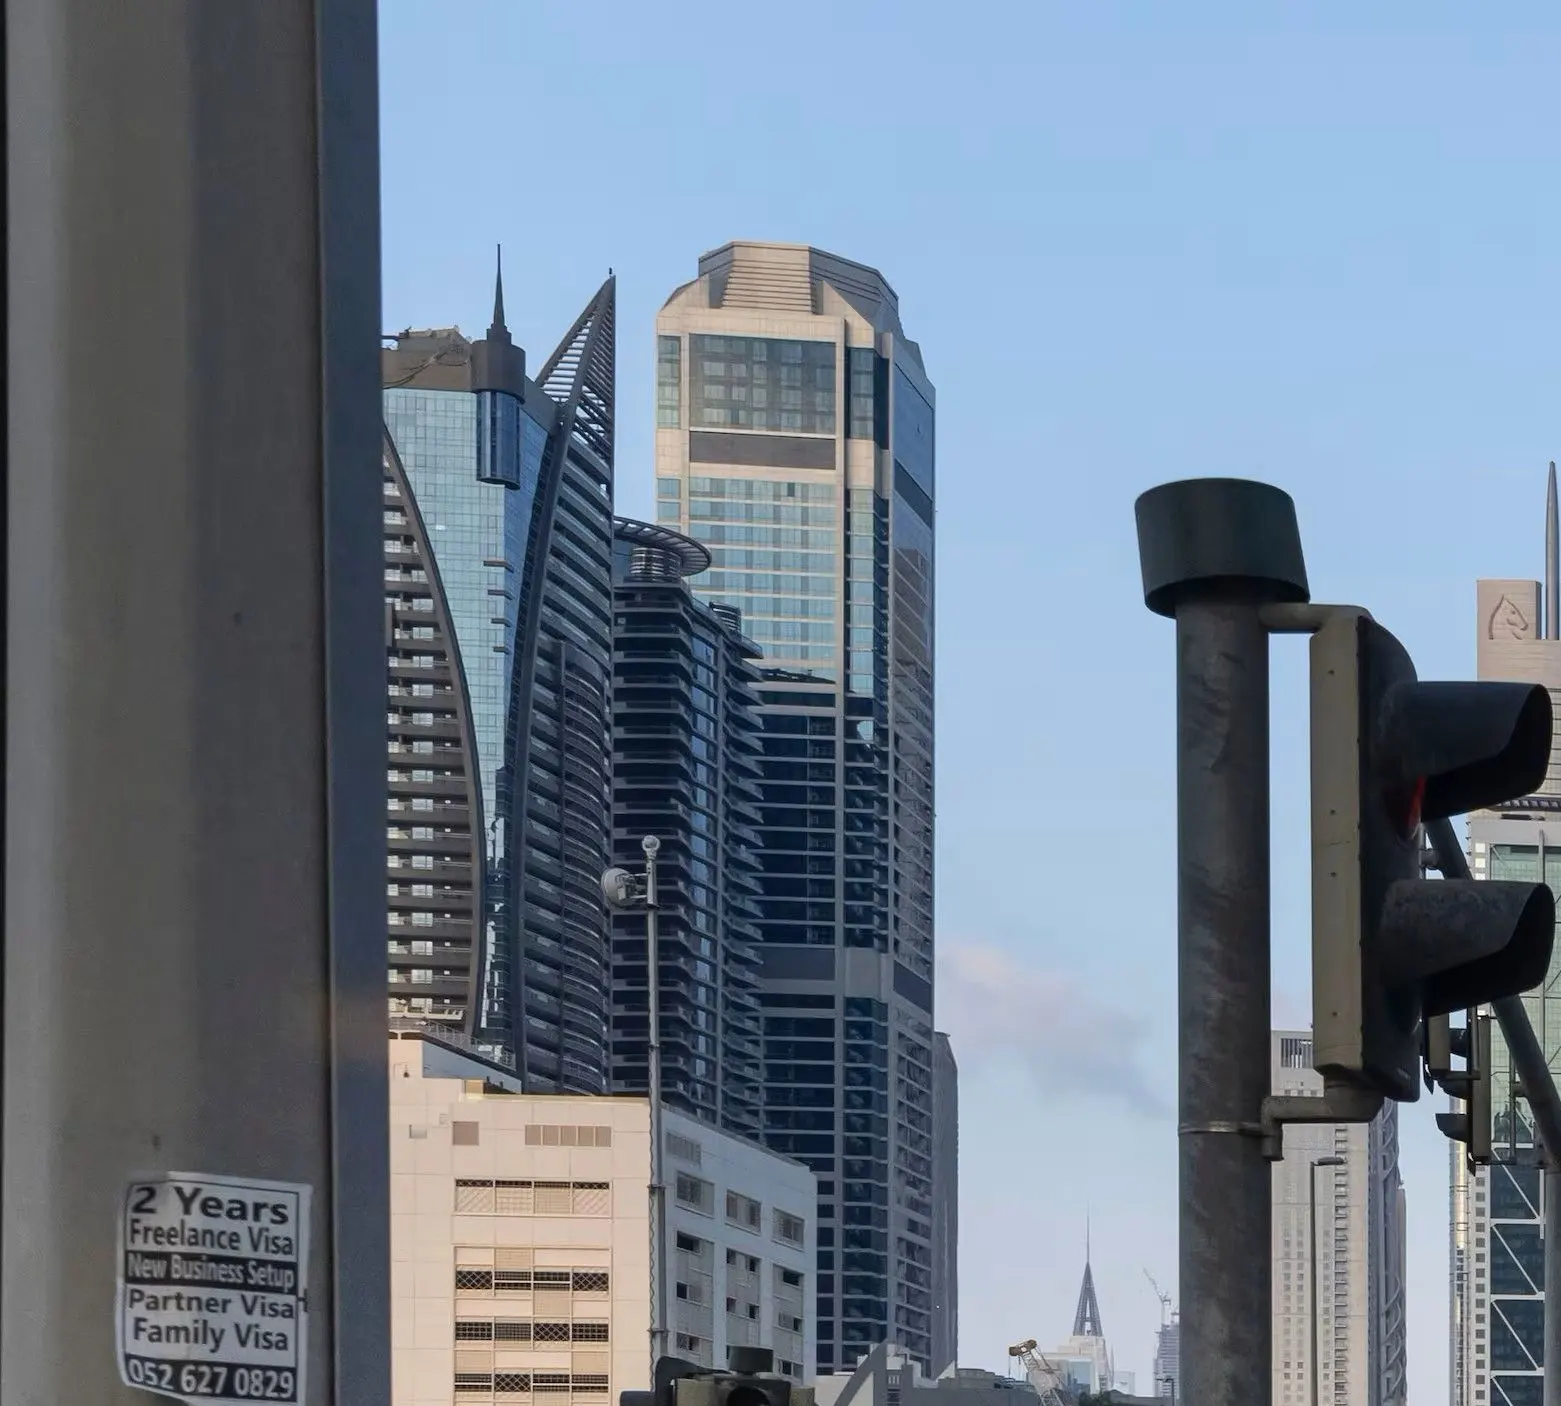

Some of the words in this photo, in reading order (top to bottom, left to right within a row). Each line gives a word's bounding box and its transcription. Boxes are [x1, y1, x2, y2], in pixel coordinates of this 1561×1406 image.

[131, 1186, 157, 1214] 2
[173, 1186, 289, 1225] Years
[129, 1218, 241, 1250] Freelance
[248, 1226, 293, 1256] Visa
[127, 1252, 167, 1278] New
[170, 1253, 244, 1283] Business
[247, 1260, 295, 1293] Setup
[129, 1288, 231, 1314] Partner
[241, 1294, 295, 1319] Visa
[133, 1317, 225, 1354] Family
[234, 1322, 288, 1351] Visa
[128, 1358, 175, 1390] 052
[180, 1364, 228, 1394] 627
[234, 1368, 294, 1398] 0829
